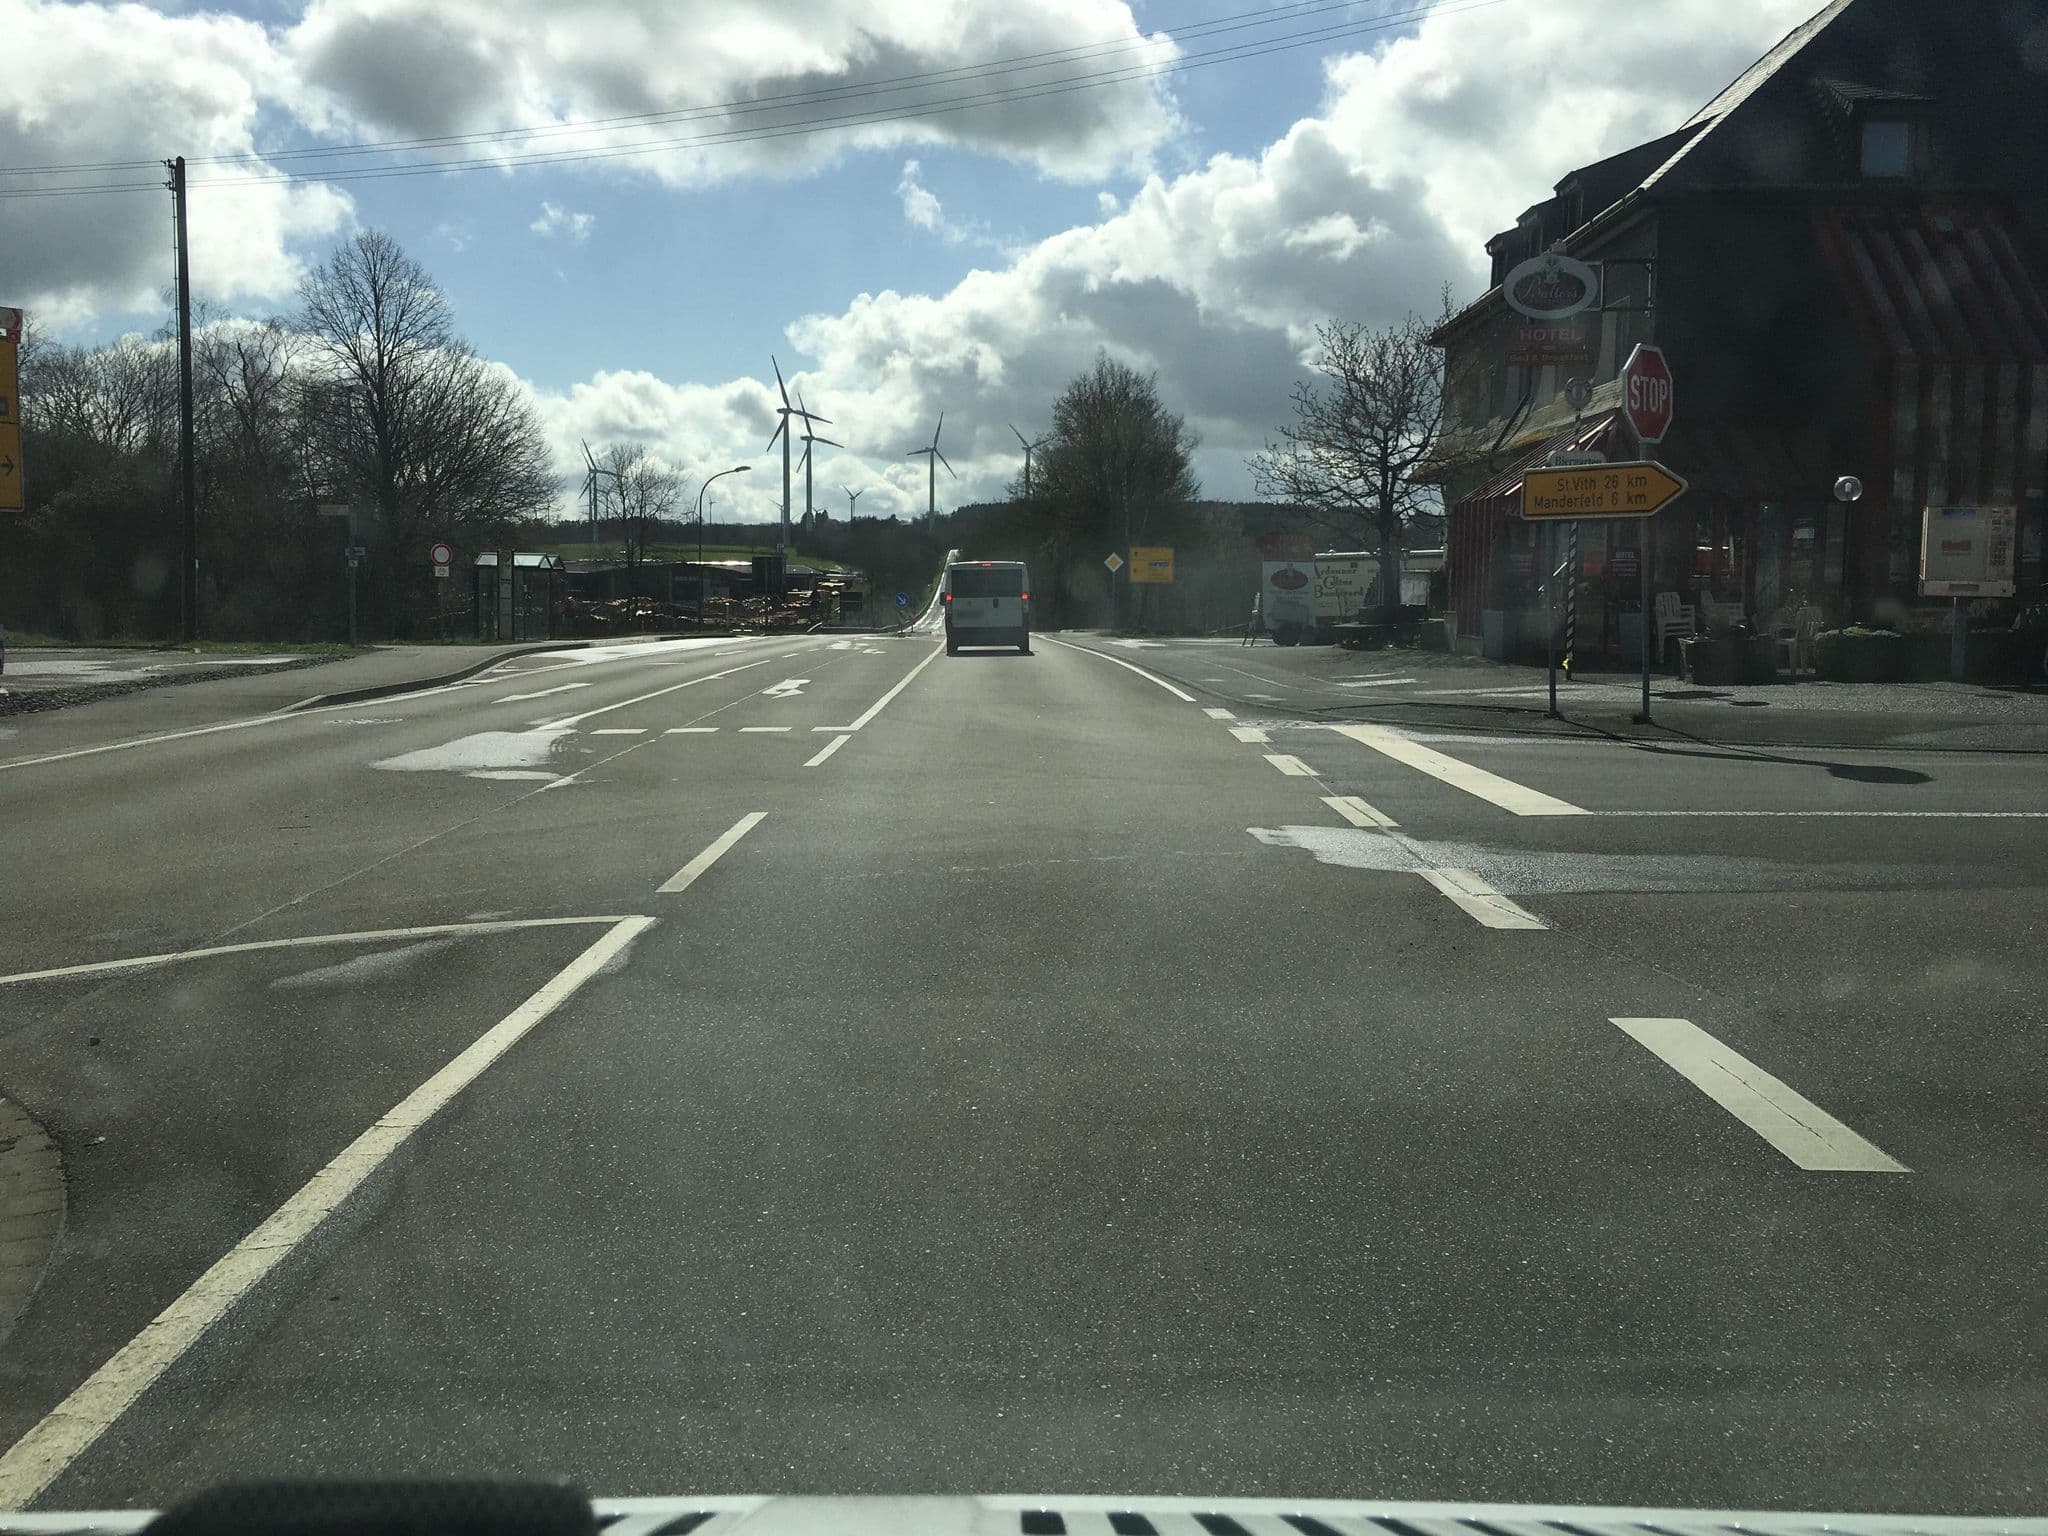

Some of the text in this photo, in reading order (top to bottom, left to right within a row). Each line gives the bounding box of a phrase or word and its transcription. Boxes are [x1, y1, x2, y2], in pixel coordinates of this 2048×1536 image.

[1519, 327, 1582, 342] HOTEL
[1631, 375, 1667, 415] STOP
[1627, 474, 1647, 489] km
[1534, 493, 1604, 510] Manderfeld
[1627, 491, 1647, 506] km
